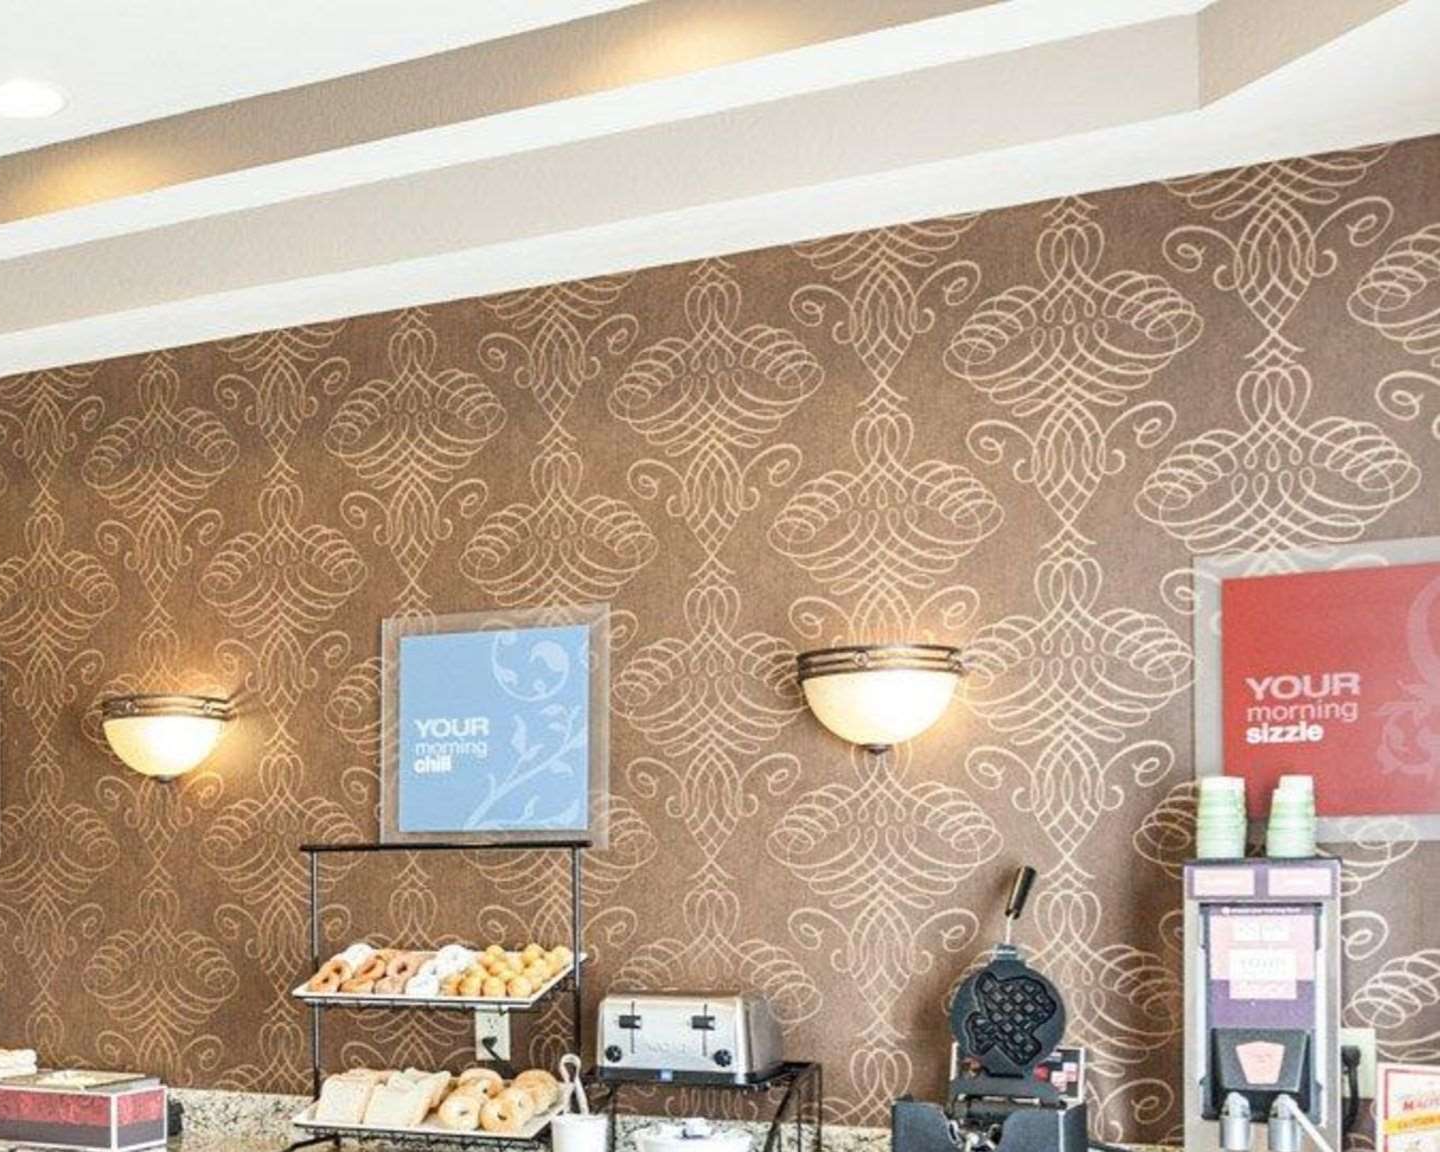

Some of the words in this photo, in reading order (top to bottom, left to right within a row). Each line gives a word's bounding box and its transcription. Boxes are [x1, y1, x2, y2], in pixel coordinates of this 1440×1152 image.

[1245, 671, 1361, 701] YOUR
[1246, 699, 1359, 723] morning
[413, 716, 490, 738] YOUR
[1245, 720, 1325, 744] sizzle
[415, 741, 488, 760] morning
[413, 755, 452, 774] chill
